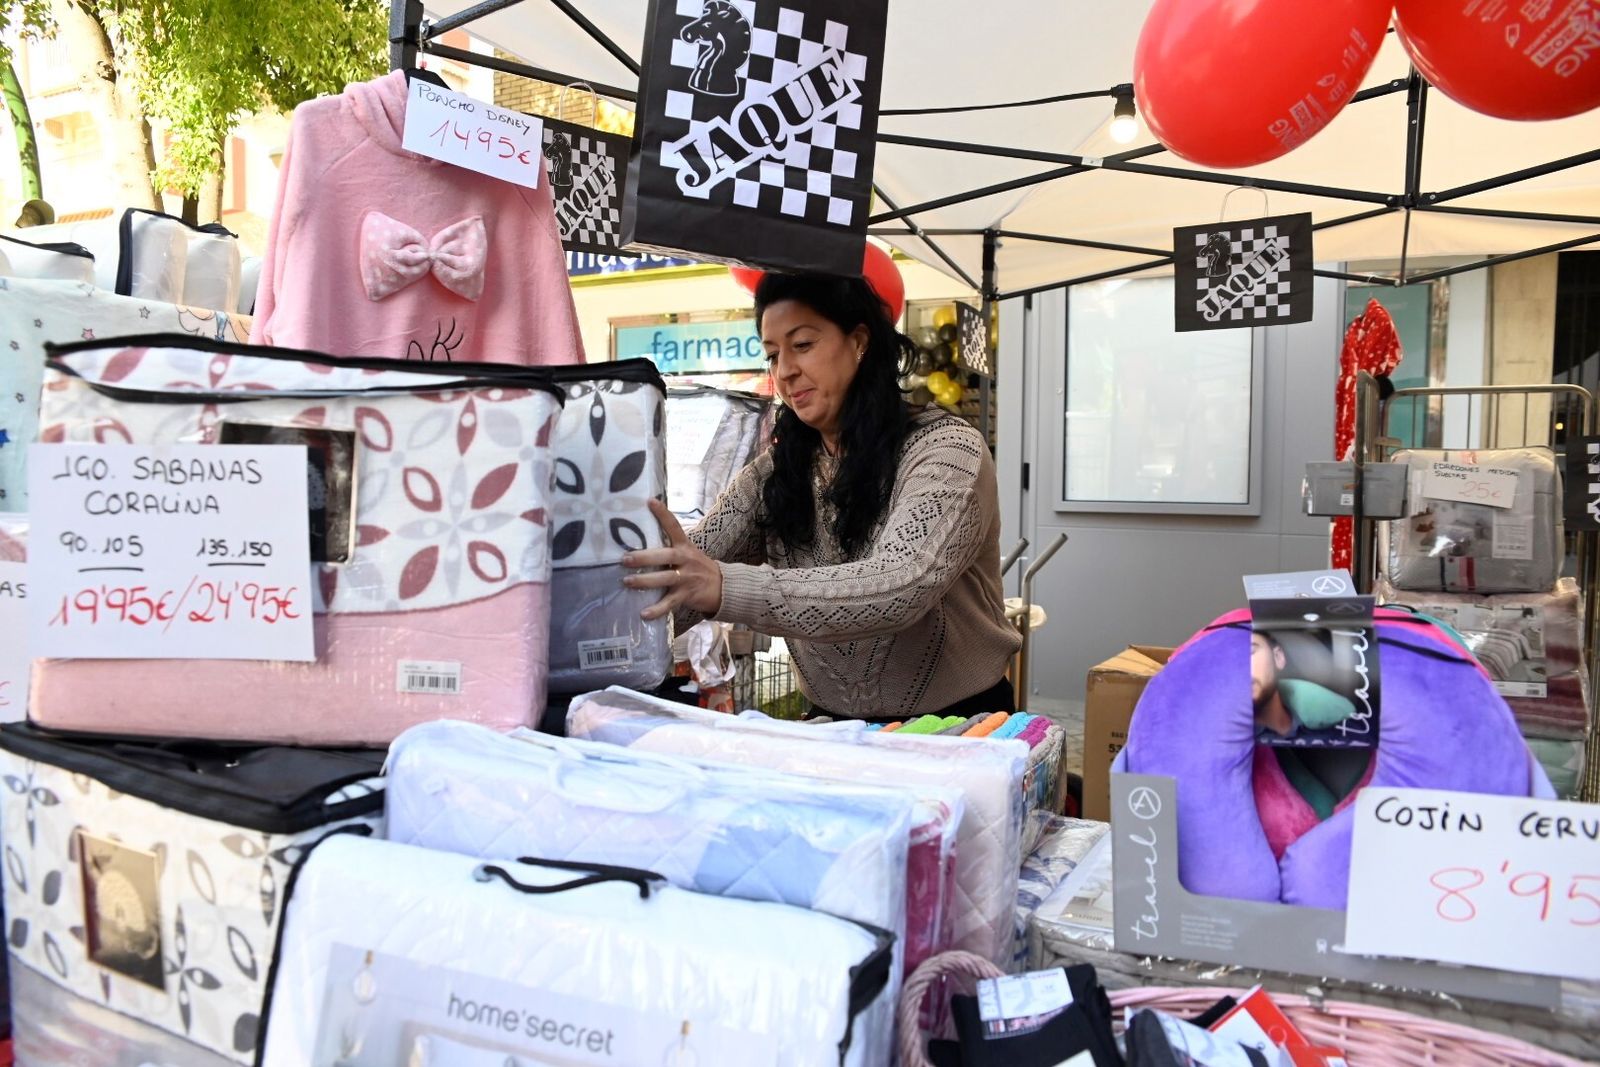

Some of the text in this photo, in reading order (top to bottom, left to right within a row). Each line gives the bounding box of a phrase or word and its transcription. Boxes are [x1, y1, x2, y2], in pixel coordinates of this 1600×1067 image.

[417, 83, 530, 136] PONCHO DISNEY
[673, 56, 852, 188] JAQUE
[429, 119, 531, 165] 14'95€
[554, 163, 613, 236] JAQUE
[1200, 245, 1285, 318] JAQUE
[651, 331, 762, 362] farmac
[133, 456, 263, 484] SABANAS
[447, 991, 615, 1057] home'secret
